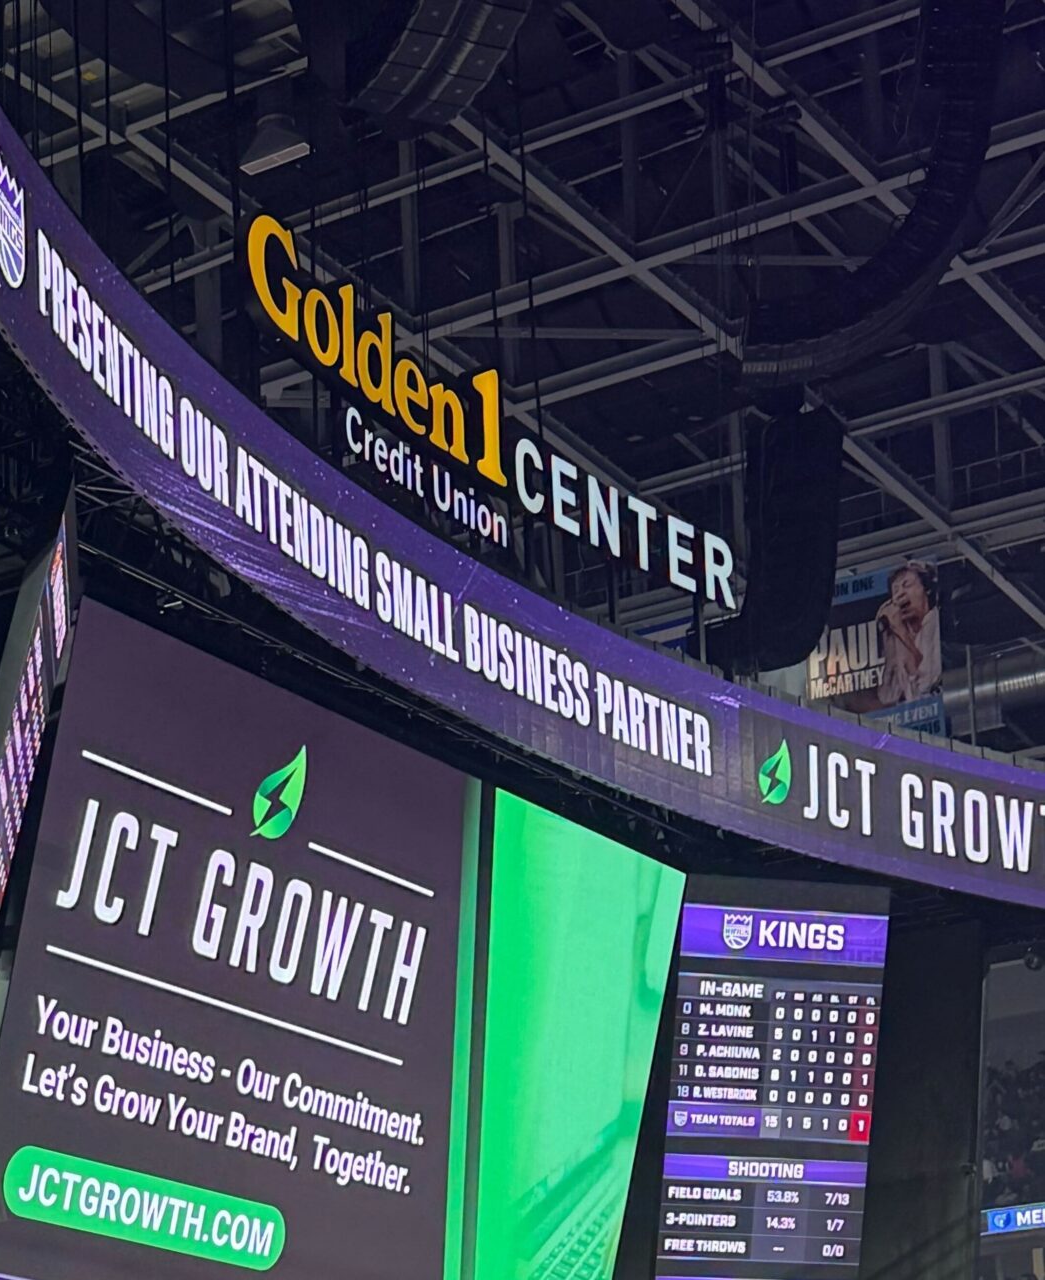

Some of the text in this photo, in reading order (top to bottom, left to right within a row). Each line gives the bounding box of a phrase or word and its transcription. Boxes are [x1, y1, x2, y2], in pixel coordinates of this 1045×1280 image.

[248, 214, 507, 487] Golden 1
[37, 229, 712, 777] PRESENTING OUR ATTENDING SMALL BUSINESS PARTNER
[346, 406, 507, 548] Credit Union
[515, 438, 736, 610] CENTER
[810, 620, 885, 679] PAUL
[811, 667, 885, 700] McCARTNEY
[804, 745, 1045, 872] JCT GROW
[55, 799, 426, 1025] JCT GROWTH
[759, 920, 845, 950] KINGS
[700, 981, 763, 998] IN-GAME
[37, 995, 424, 1145] Your Business Our Commitment.
[23, 1053, 411, 1194] Let's Grow Your Brand, Together.
[728, 1161, 804, 1179] SHOOTING
[18, 1164, 274, 1257] JCTGROWTH.COM
[666, 1213, 843, 1231] 3-POINTERS 14.3% 1/7
[668, 1186, 849, 1205] FIELD GOALS 53.8% 7/13
[665, 1239, 843, 1257] FREE THROWS 0/0
